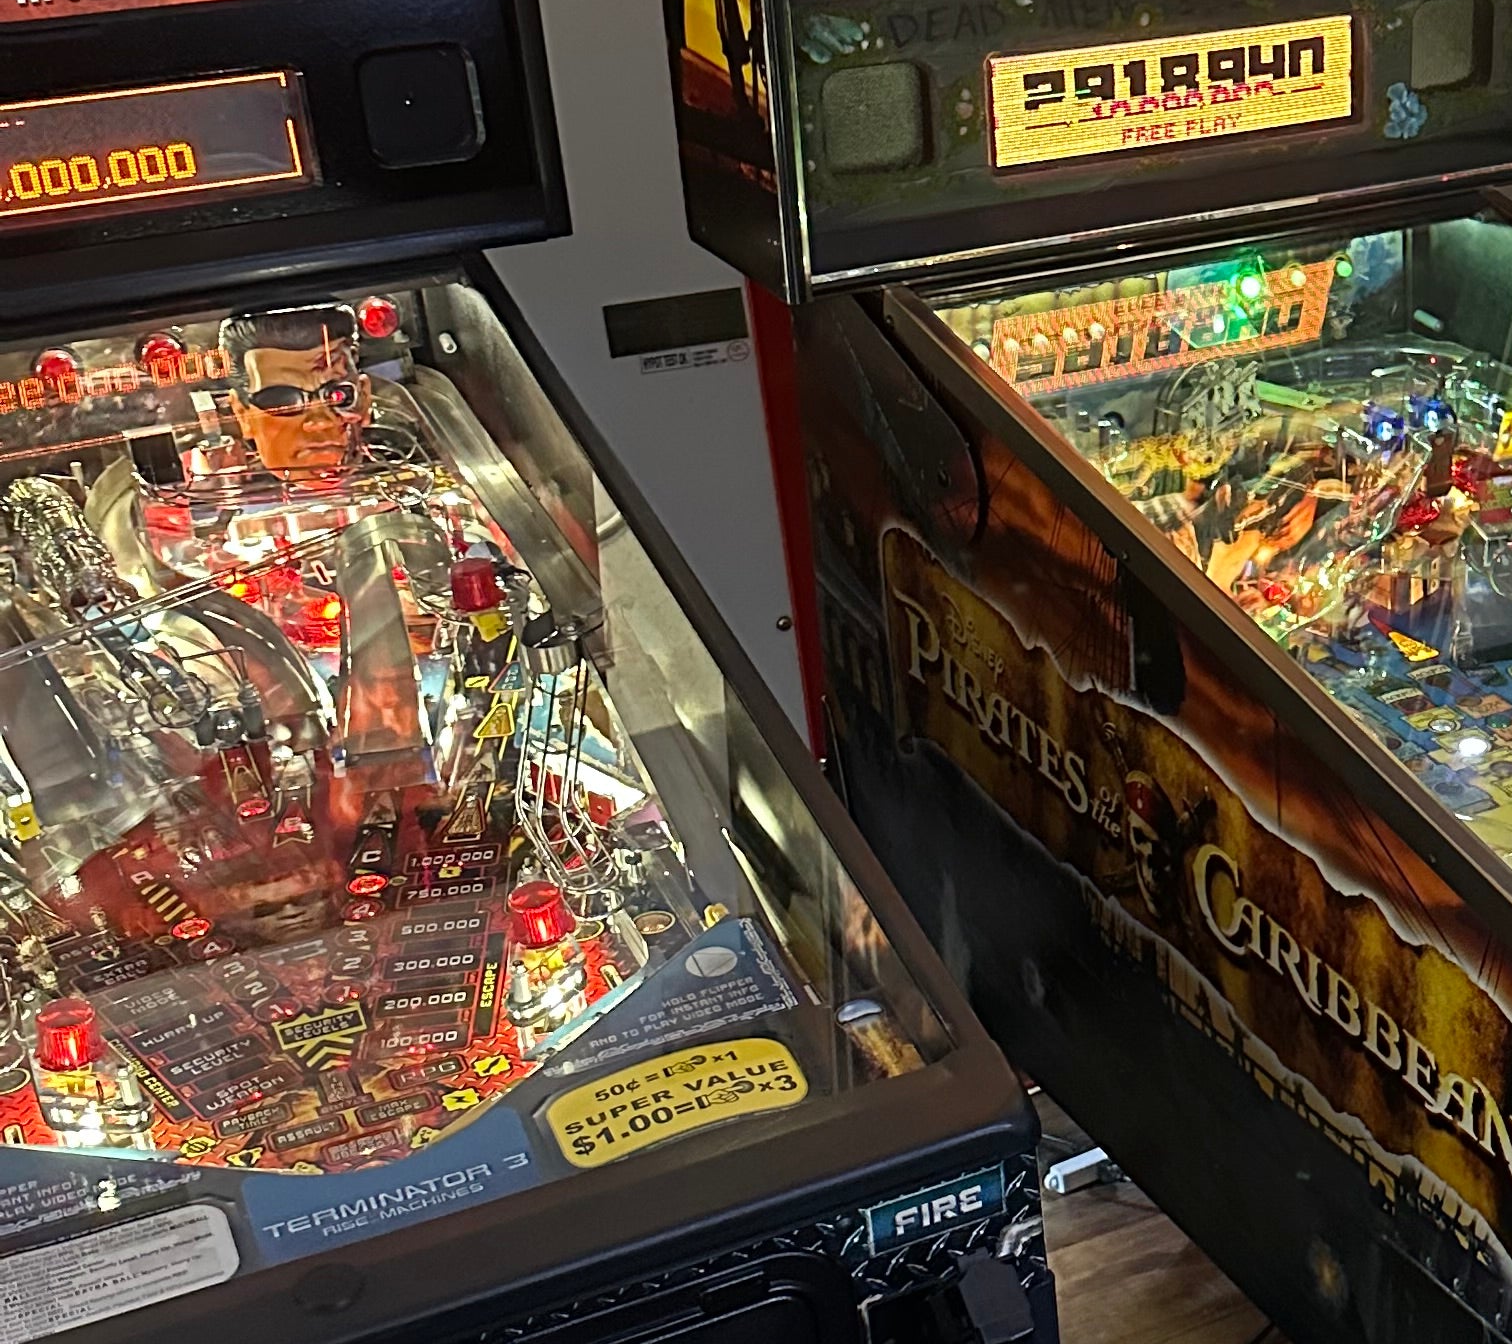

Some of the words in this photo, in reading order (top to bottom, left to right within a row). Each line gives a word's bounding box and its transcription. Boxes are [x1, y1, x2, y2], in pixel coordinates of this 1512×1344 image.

[887, 2, 998, 46] DEAD
[1121, 122, 1177, 143] FREE
[1186, 114, 1242, 136] PLAY
[0, 143, 197, 203] ,000,000
[893, 587, 1088, 814] PIRATES
[480, 962, 498, 1008] ESCAPE
[701, 976, 754, 999] FLIPPER
[202, 1011, 225, 1025] UP
[644, 1018, 678, 1034] PLAY
[170, 1039, 251, 1076] SECURITY
[191, 1052, 247, 1076] LEVEL
[144, 1076, 180, 1108] CENTER
[206, 1076, 285, 1112] WEAPON
[216, 1076, 261, 1099] SPOT
[565, 1089, 674, 1135] SUPER
[684, 1060, 790, 1092] VALUE
[594, 1078, 641, 1102] 50¢
[262, 1161, 493, 1239] TERMINATOR
[503, 1152, 530, 1170] 3
[323, 1214, 371, 1237] RISE
[380, 1182, 486, 1221] MACHINES
[895, 1185, 984, 1235] FIRE
